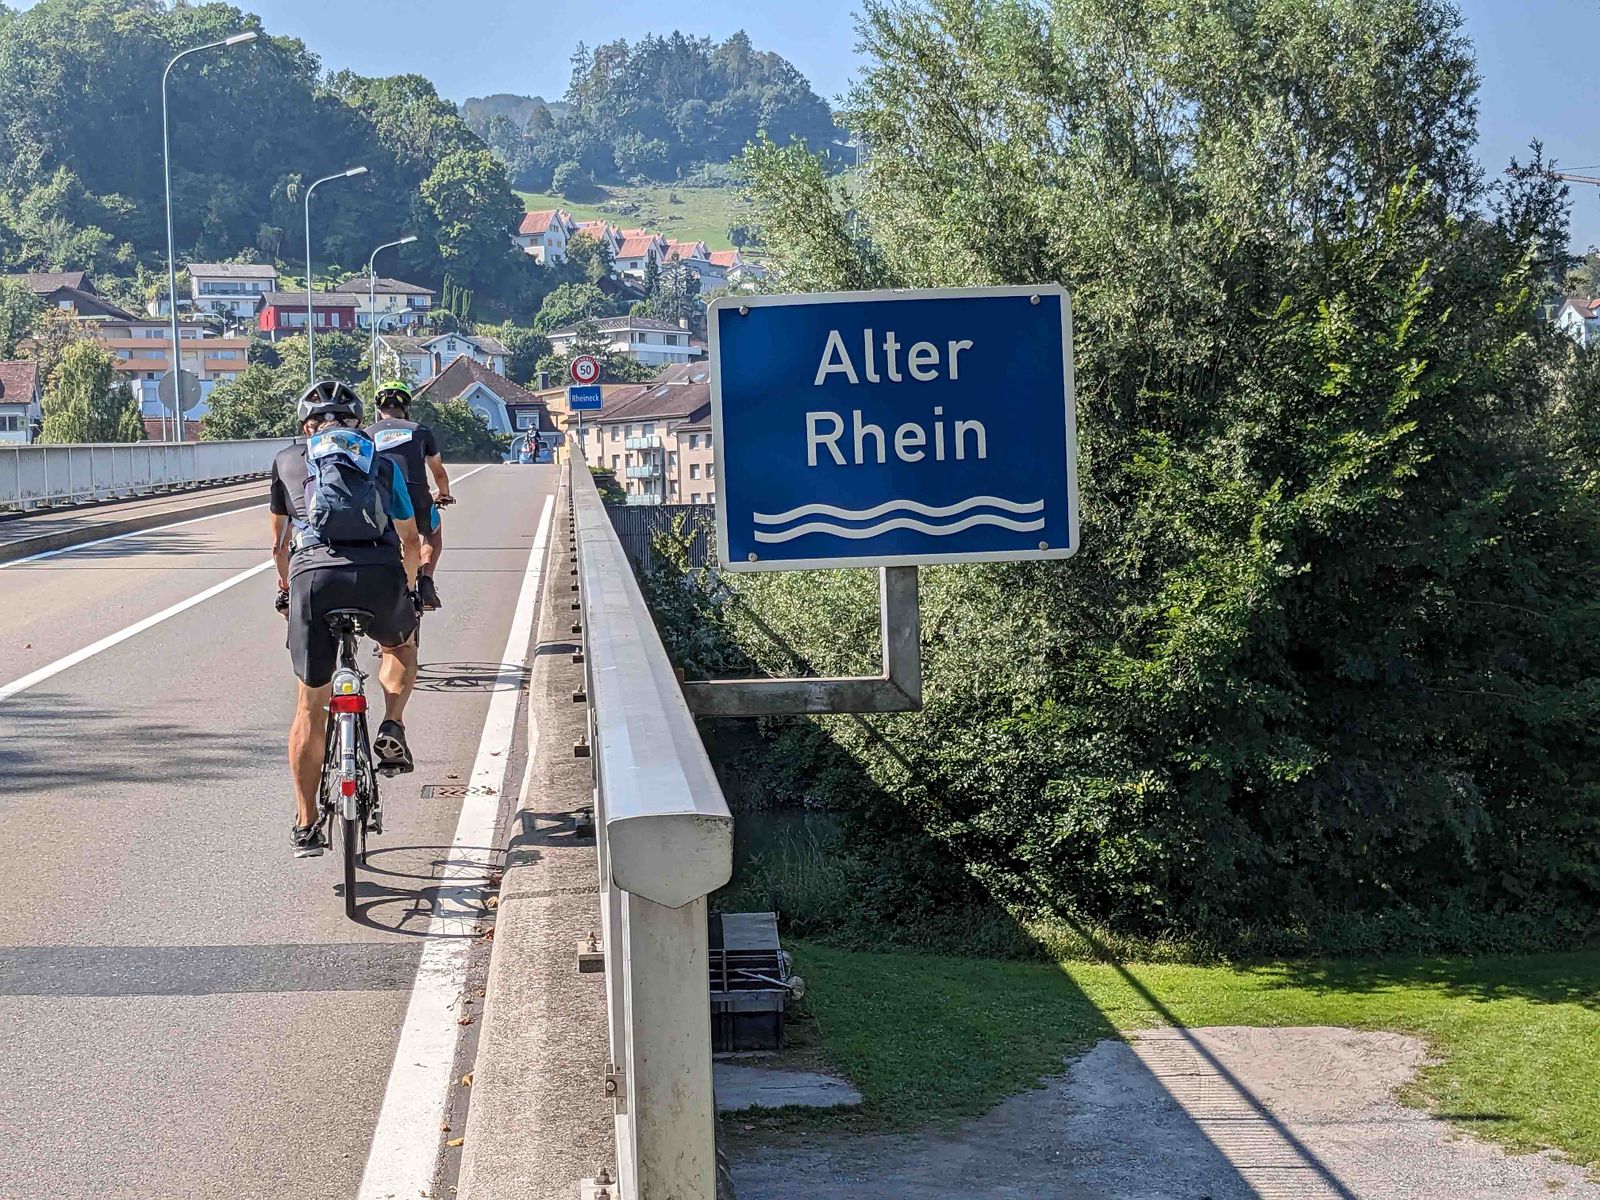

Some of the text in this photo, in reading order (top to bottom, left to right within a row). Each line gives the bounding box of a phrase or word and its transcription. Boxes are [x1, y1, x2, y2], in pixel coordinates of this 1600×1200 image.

[580, 365, 592, 375] 50
[814, 328, 974, 386] Alter
[572, 394, 599, 402] Rheineck
[806, 406, 987, 467] Rhein
